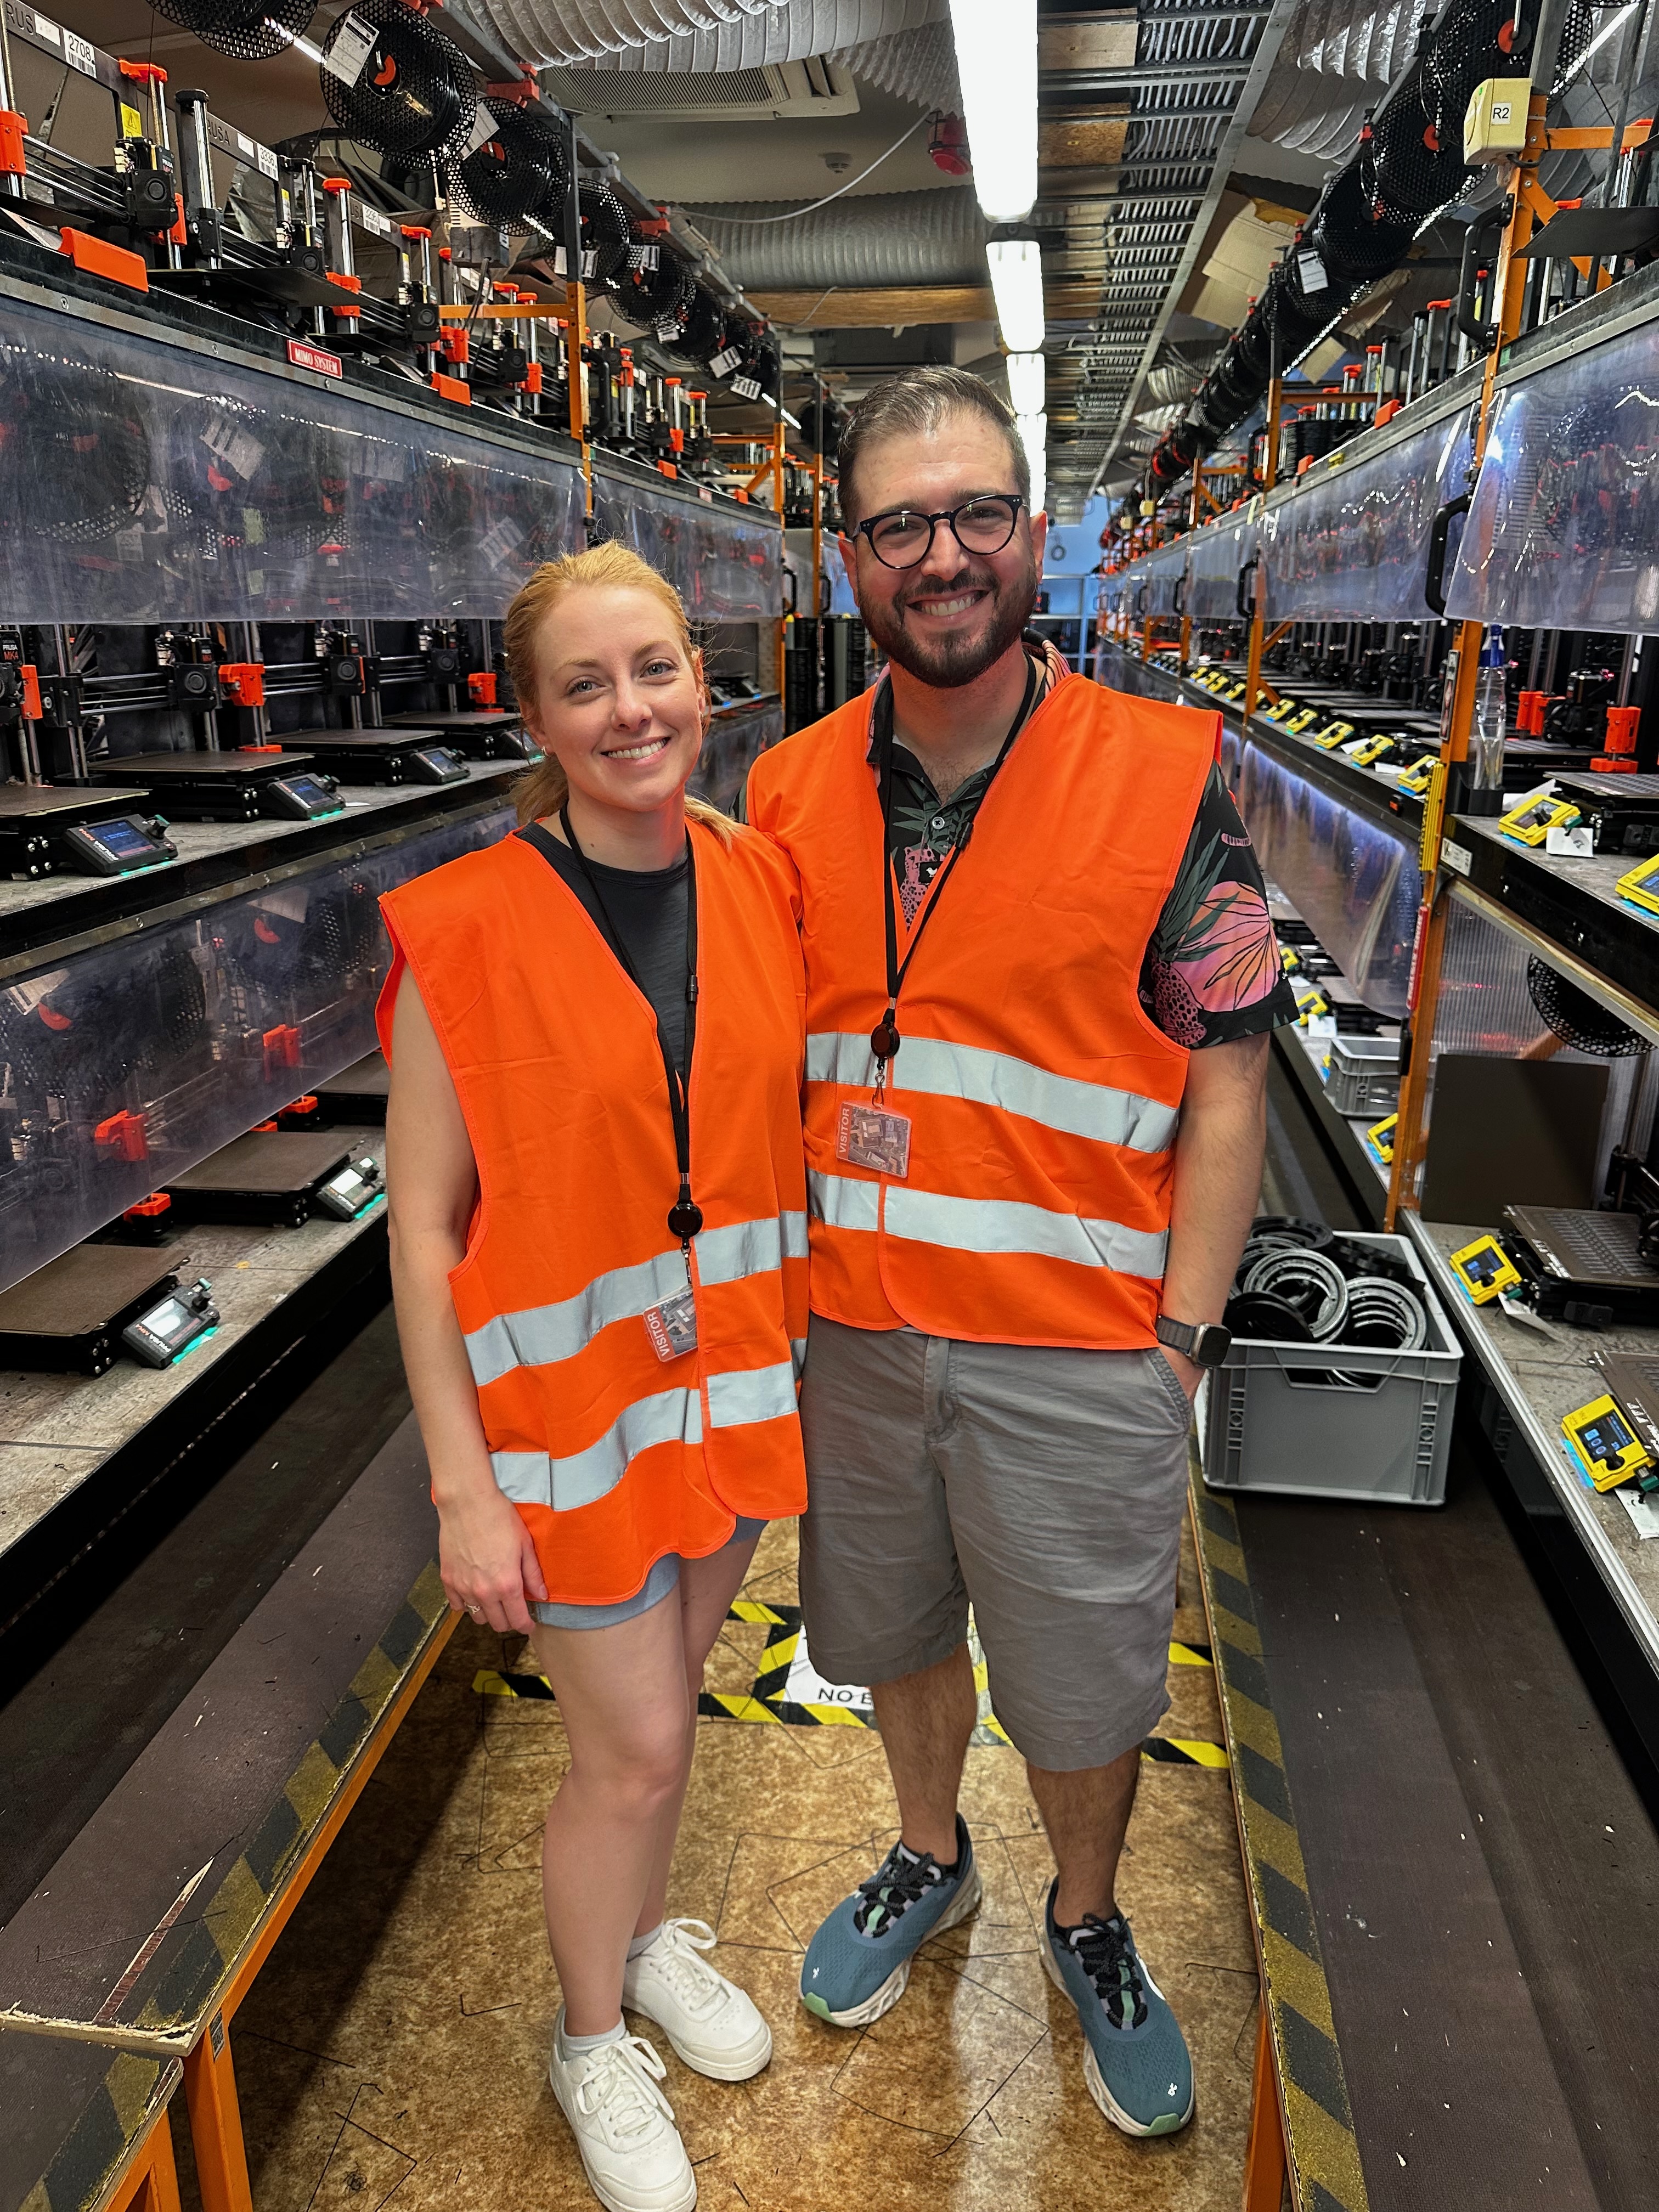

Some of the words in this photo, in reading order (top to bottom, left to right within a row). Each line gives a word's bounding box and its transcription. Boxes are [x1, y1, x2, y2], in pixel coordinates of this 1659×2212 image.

[5, 2, 44, 41] RUS
[1493, 107, 1509, 119] R2
[295, 347, 313, 365] MIMO
[839, 1108, 850, 1153] VISITOR
[647, 1311, 670, 1357] VISITOR
[817, 1688, 853, 1702] NO
